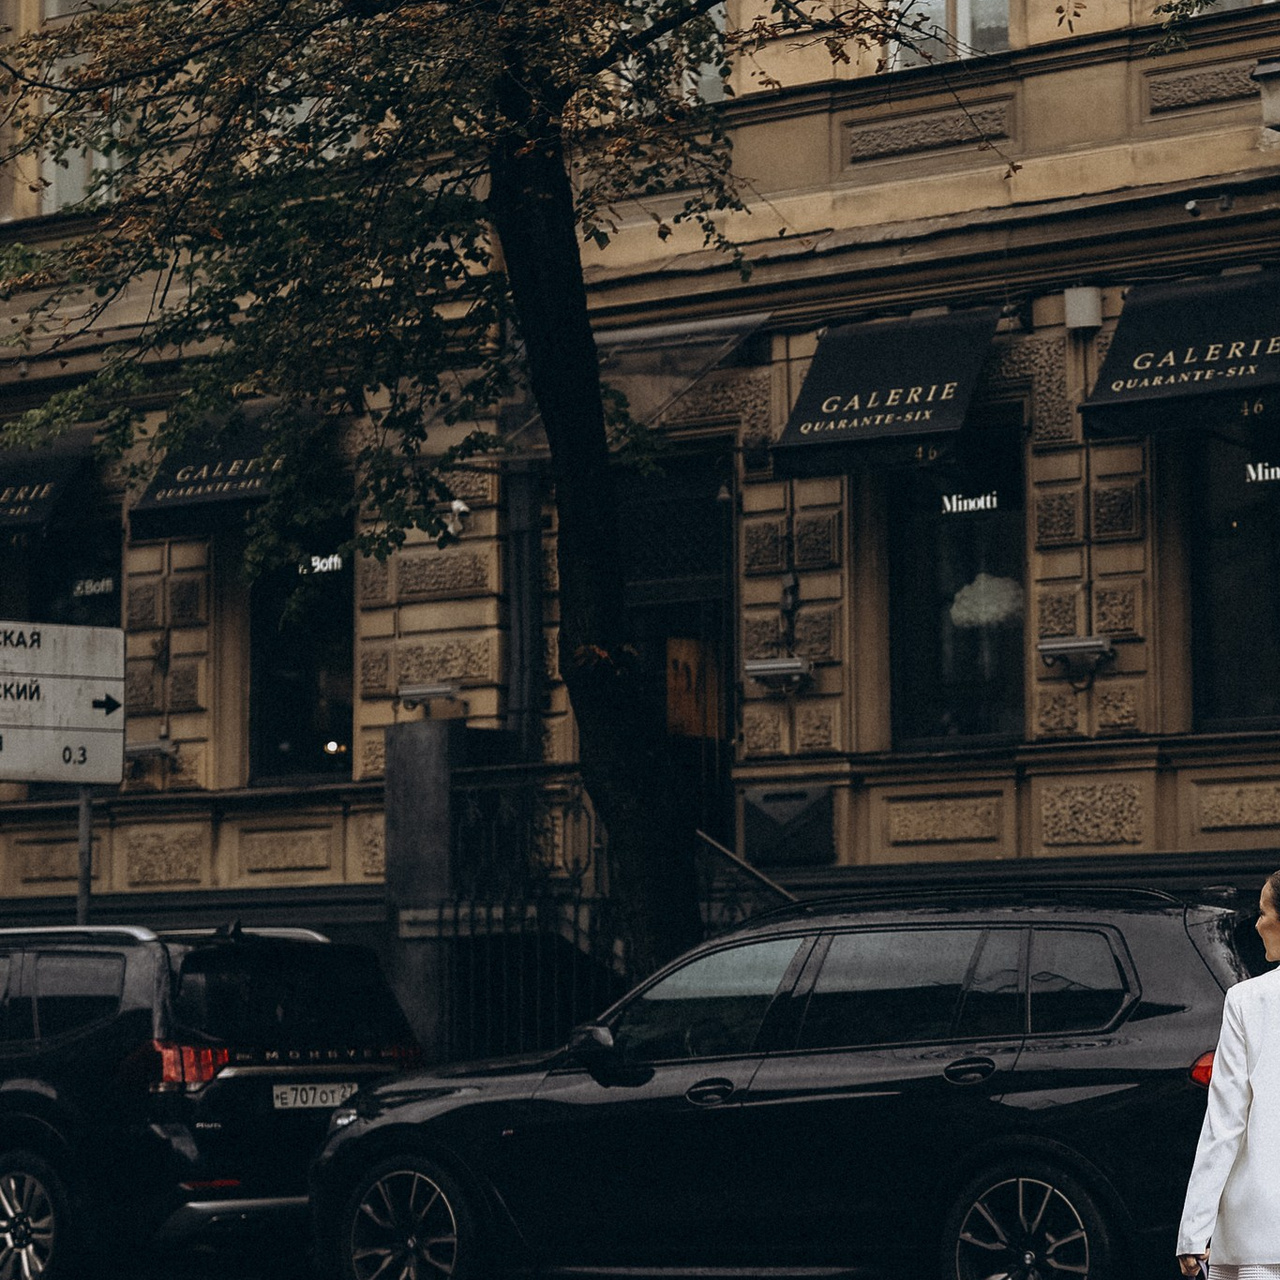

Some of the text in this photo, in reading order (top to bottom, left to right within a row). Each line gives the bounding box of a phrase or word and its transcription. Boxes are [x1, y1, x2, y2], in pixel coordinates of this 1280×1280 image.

[1110, 364, 1259, 393] QUARANTE-SIX
[820, 381, 959, 414] GALERIE
[799, 409, 934, 435] QUARANTE-SIX
[176, 453, 287, 483] GALEE
[941, 490, 999, 515] Minotti
[0, 629, 42, 649] КАЯ
[0, 679, 41, 701] КИЙ
[62, 745, 88, 765] 0.3
